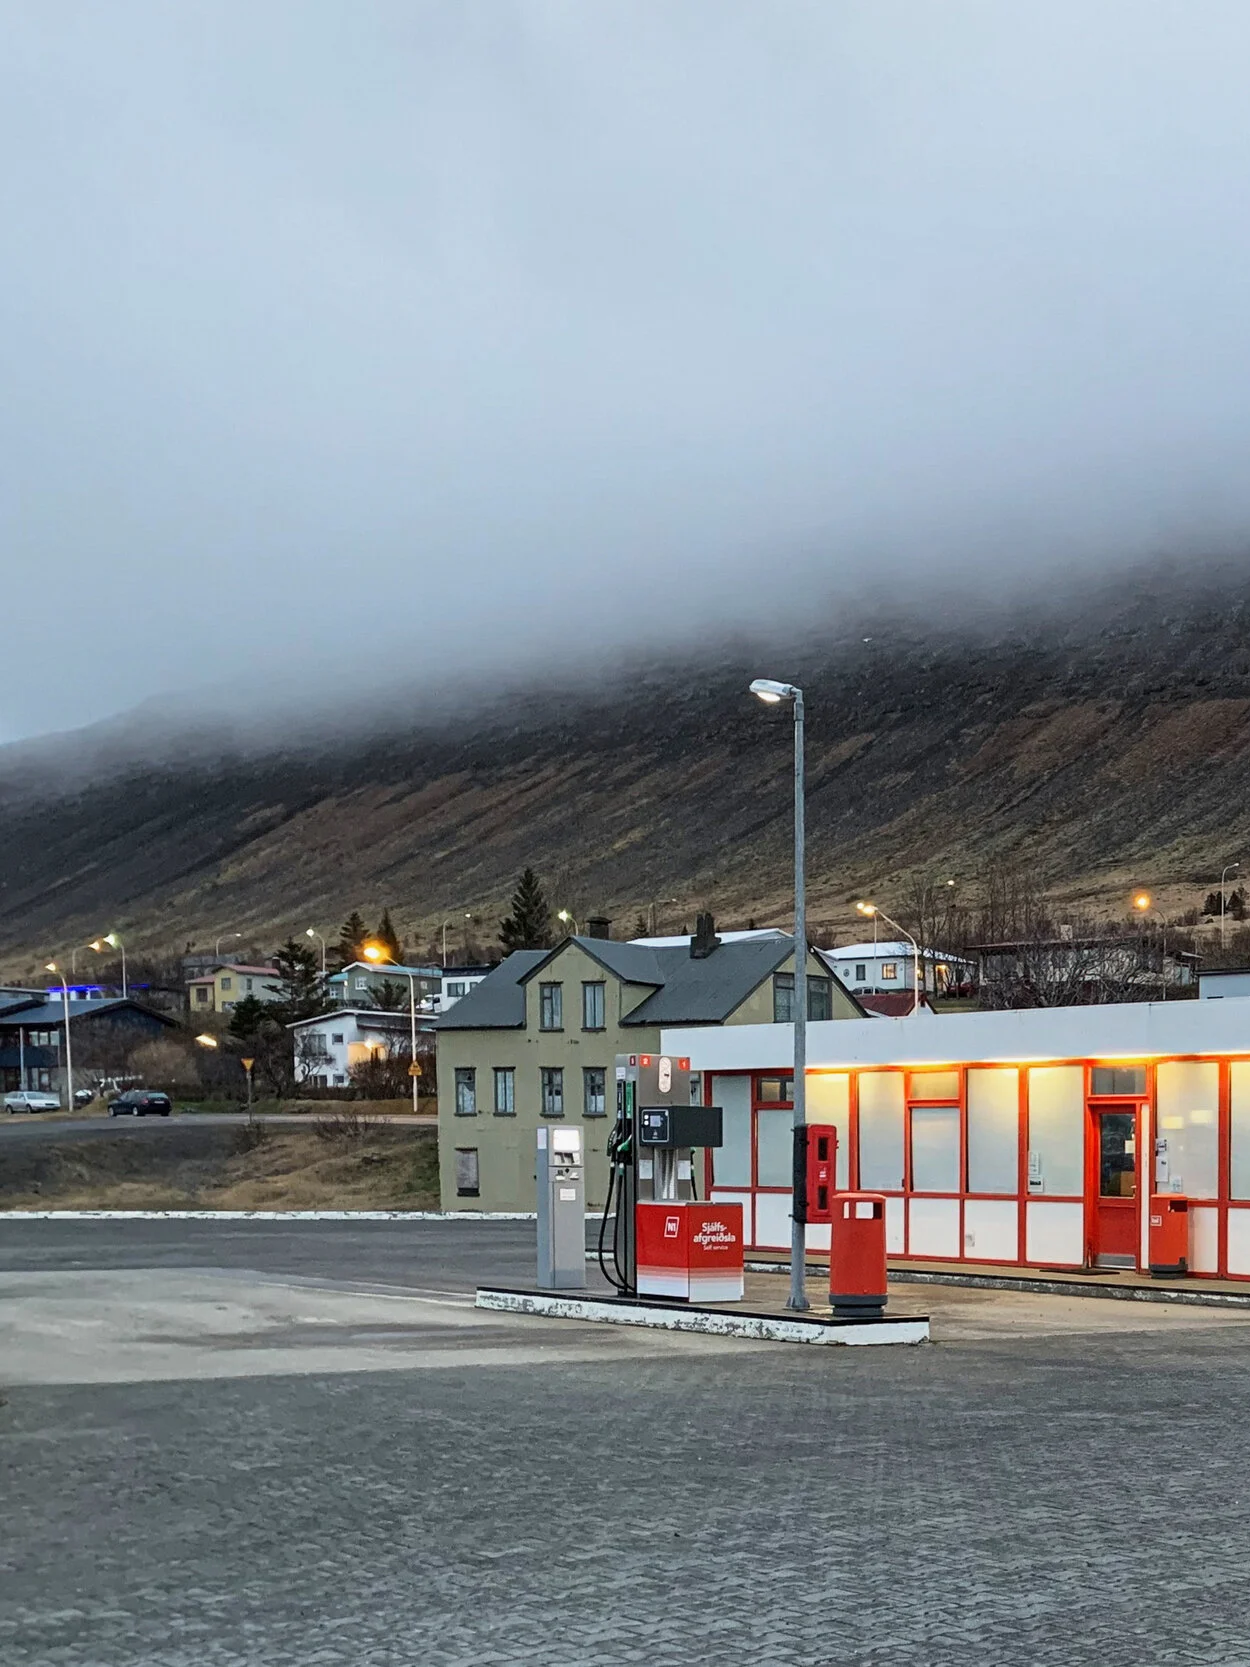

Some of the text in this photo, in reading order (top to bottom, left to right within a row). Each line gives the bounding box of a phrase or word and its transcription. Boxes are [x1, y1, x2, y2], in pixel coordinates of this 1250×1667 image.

[643, 1057, 649, 1065] 2
[681, 1061, 686, 1069] 1
[667, 1222, 677, 1232] N1
[701, 1221, 727, 1234] Sjálfs-
[693, 1232, 736, 1245] afgreiðsla
